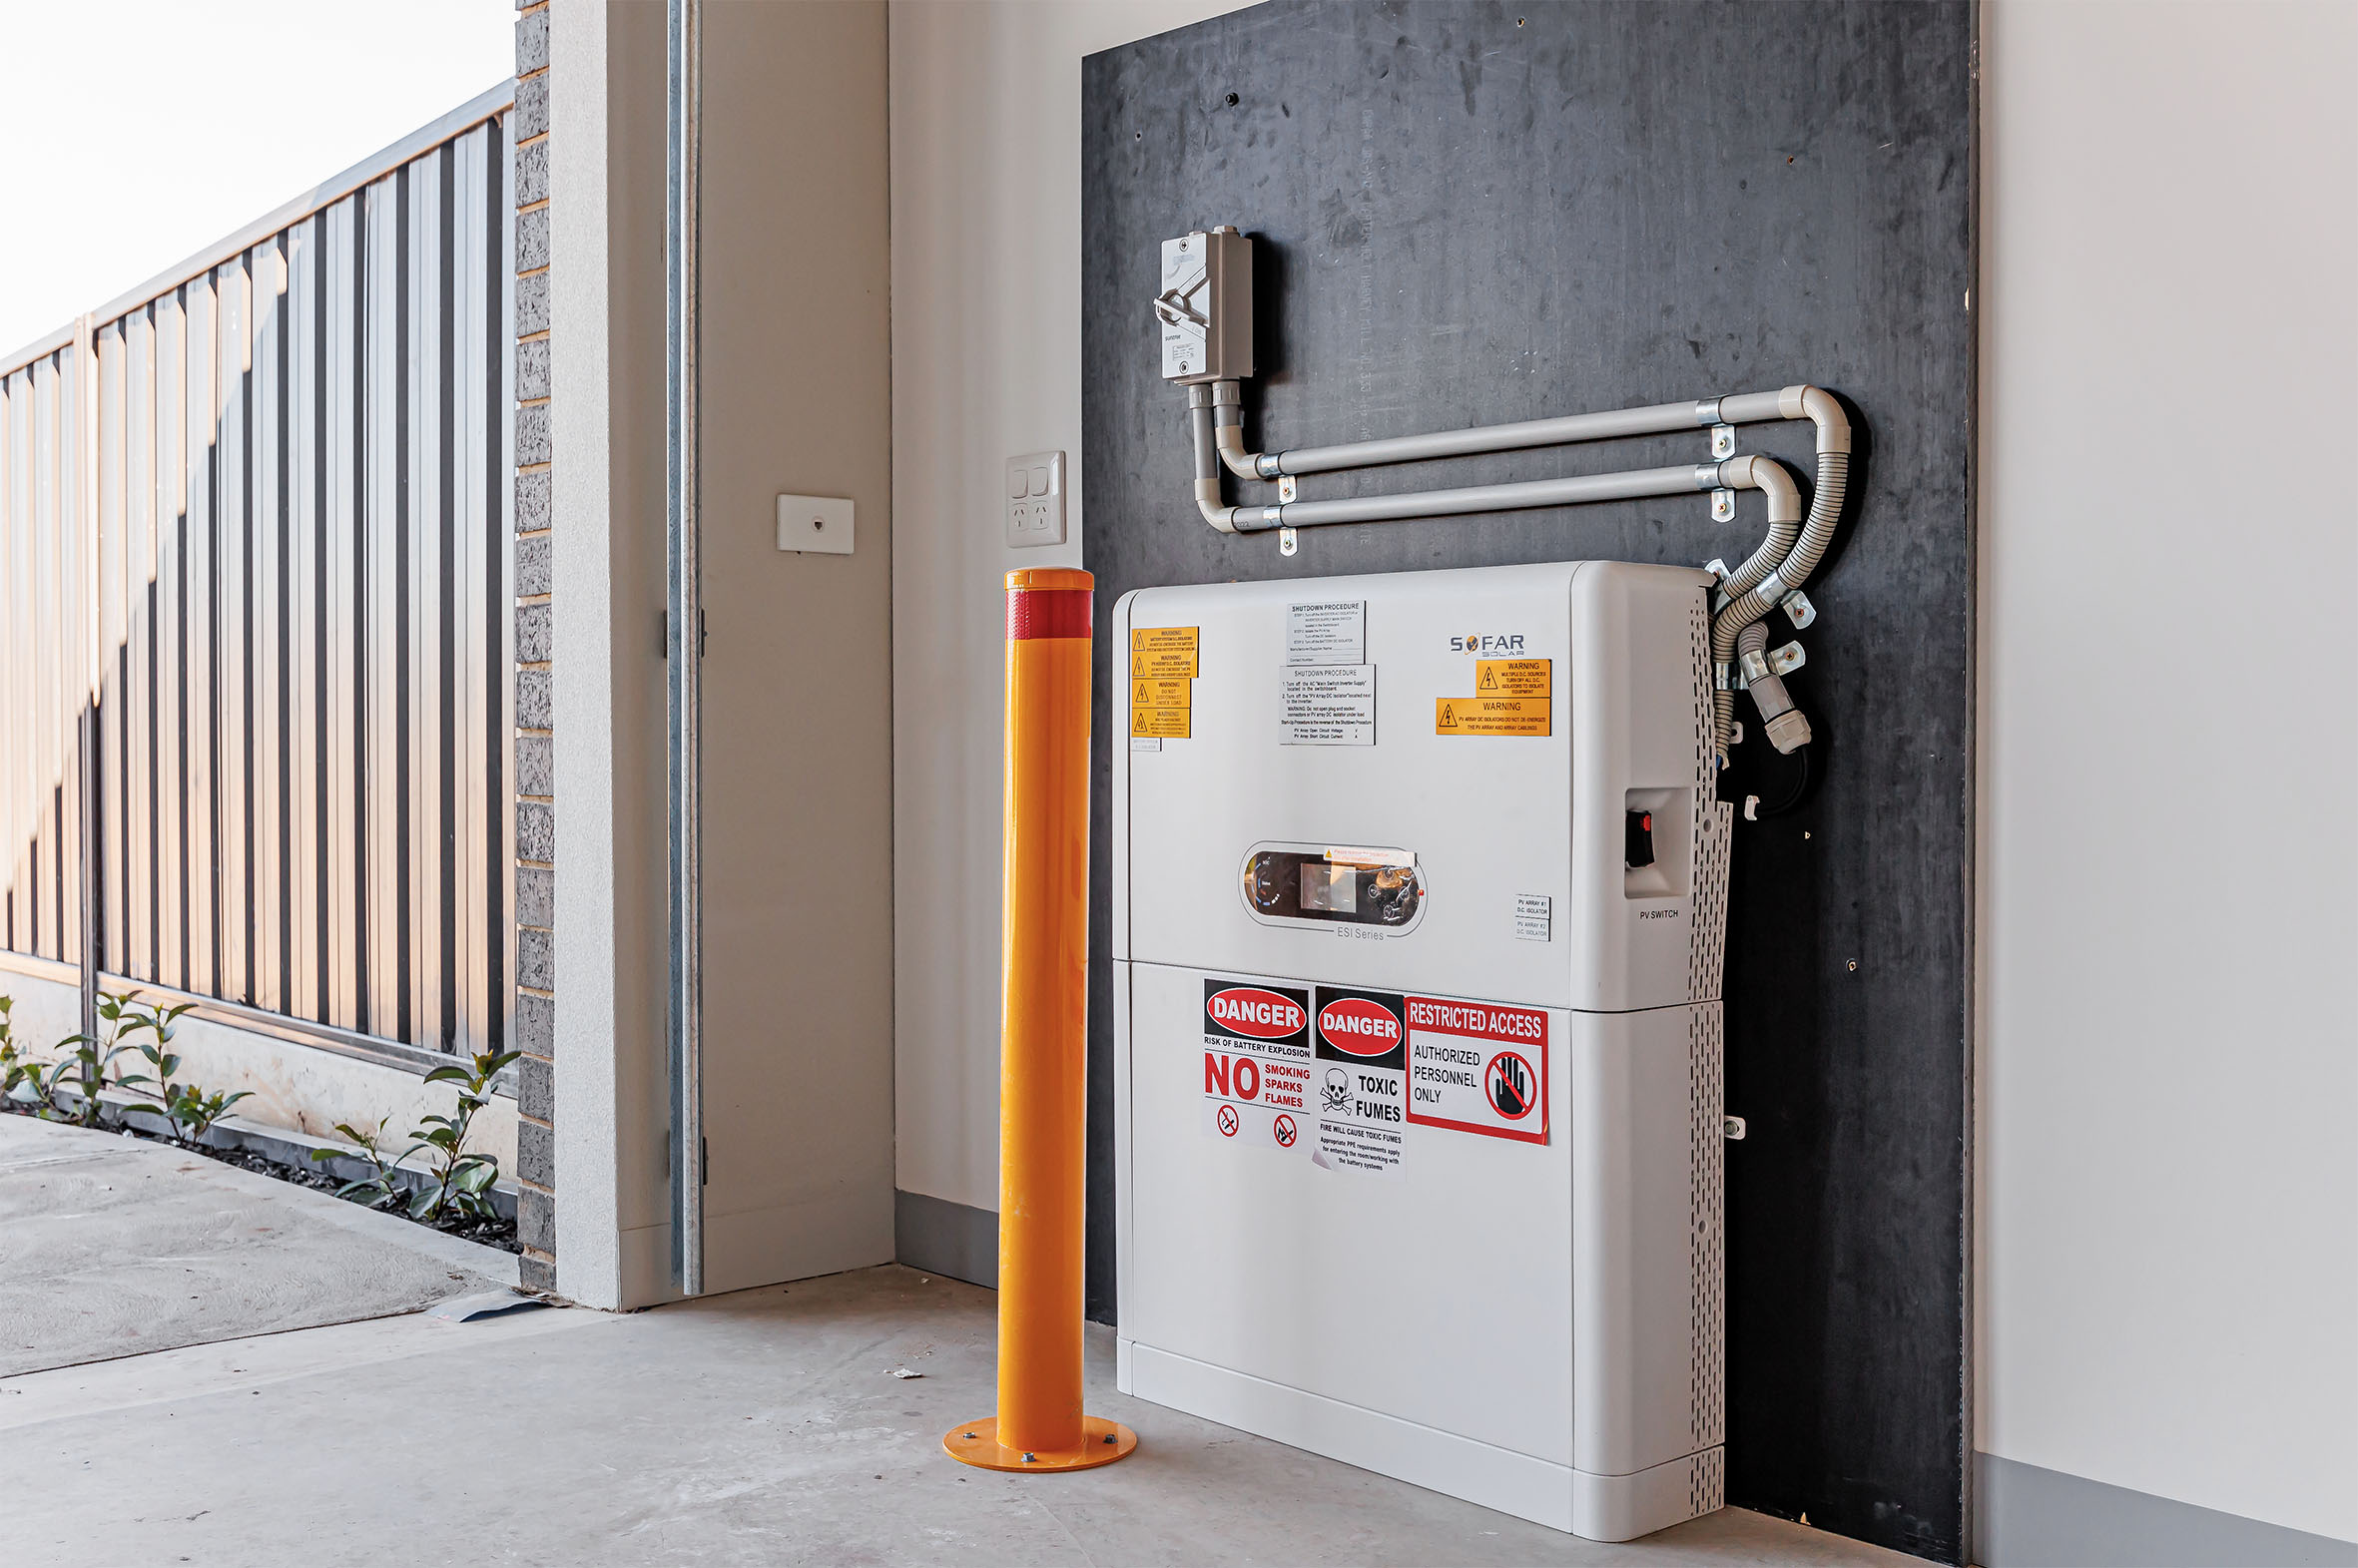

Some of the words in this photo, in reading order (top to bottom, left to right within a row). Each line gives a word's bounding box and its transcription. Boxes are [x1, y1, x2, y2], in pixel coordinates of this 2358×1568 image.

[1451, 635, 1524, 652] SOFAR
[1651, 910, 1678, 919] SWITCH
[1337, 927, 1353, 938] ESI
[1355, 928, 1384, 941] Series
[1214, 997, 1300, 1028] DANGER
[1410, 1002, 1485, 1031] RESTRICTED
[1488, 1011, 1541, 1038] ACCESS
[1323, 1013, 1398, 1039] DANGER
[1204, 1036, 1221, 1046] RISK
[1234, 1040, 1267, 1052] BATTERY
[1268, 1046, 1311, 1059] EXPLOSION
[1415, 1045, 1480, 1066] AUTHORIZED
[1205, 1052, 1260, 1100] NO
[1265, 1064, 1310, 1079] SMOKING
[1415, 1066, 1477, 1088] PERSONNEL
[1265, 1079, 1303, 1093] SPARKS
[1359, 1075, 1398, 1096] TOXIC
[1265, 1093, 1303, 1108] FLAMES
[1415, 1087, 1442, 1103] ONLY
[1357, 1101, 1401, 1123] FUMES
[1347, 1128, 1364, 1137] CAUSE
[1383, 1134, 1402, 1144] FUMES
[1321, 1137, 1346, 1146] Appropriate
[1357, 1144, 1386, 1153] requirements
[1330, 1148, 1348, 1157] entering
[1358, 1153, 1388, 1164] room/working
[1347, 1158, 1363, 1168] battery
